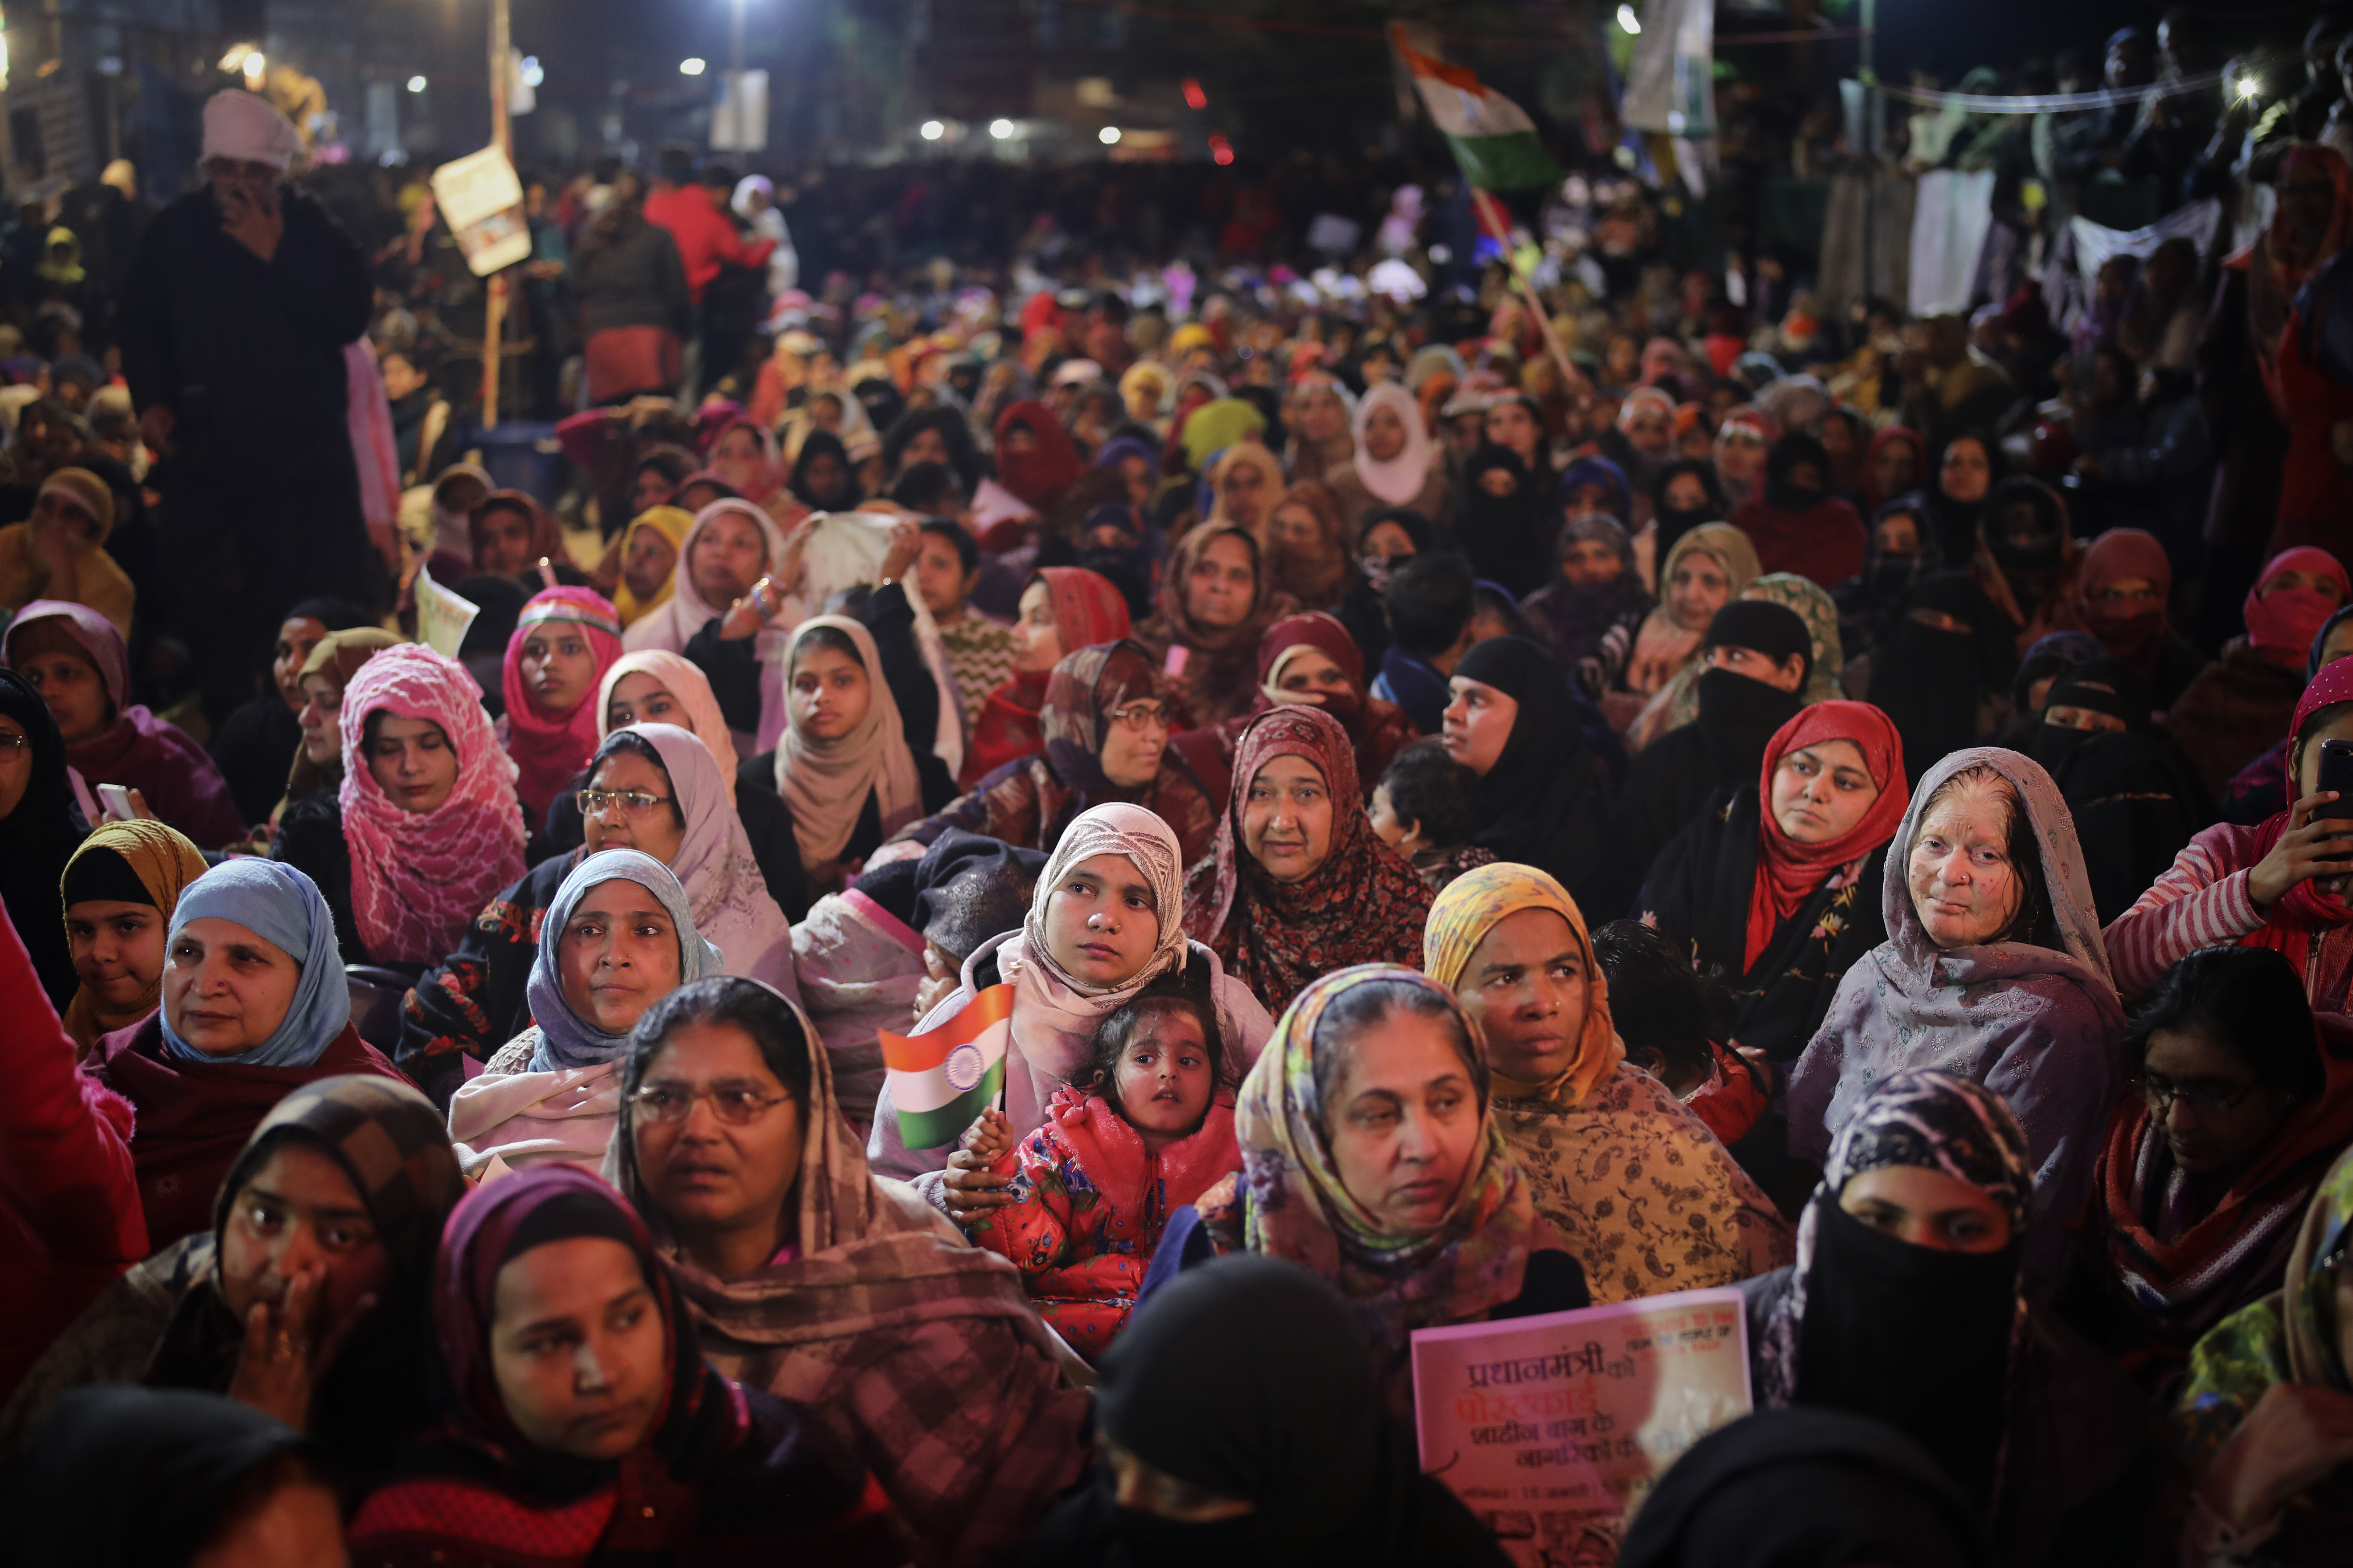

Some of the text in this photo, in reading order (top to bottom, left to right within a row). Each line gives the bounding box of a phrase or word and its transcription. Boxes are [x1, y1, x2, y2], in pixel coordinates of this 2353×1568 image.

[1467, 1340, 1605, 1389] प्रधानमंत्री
[1606, 1354, 1636, 1379] को
[1457, 1376, 1598, 1423] पोस्टकार्ड
